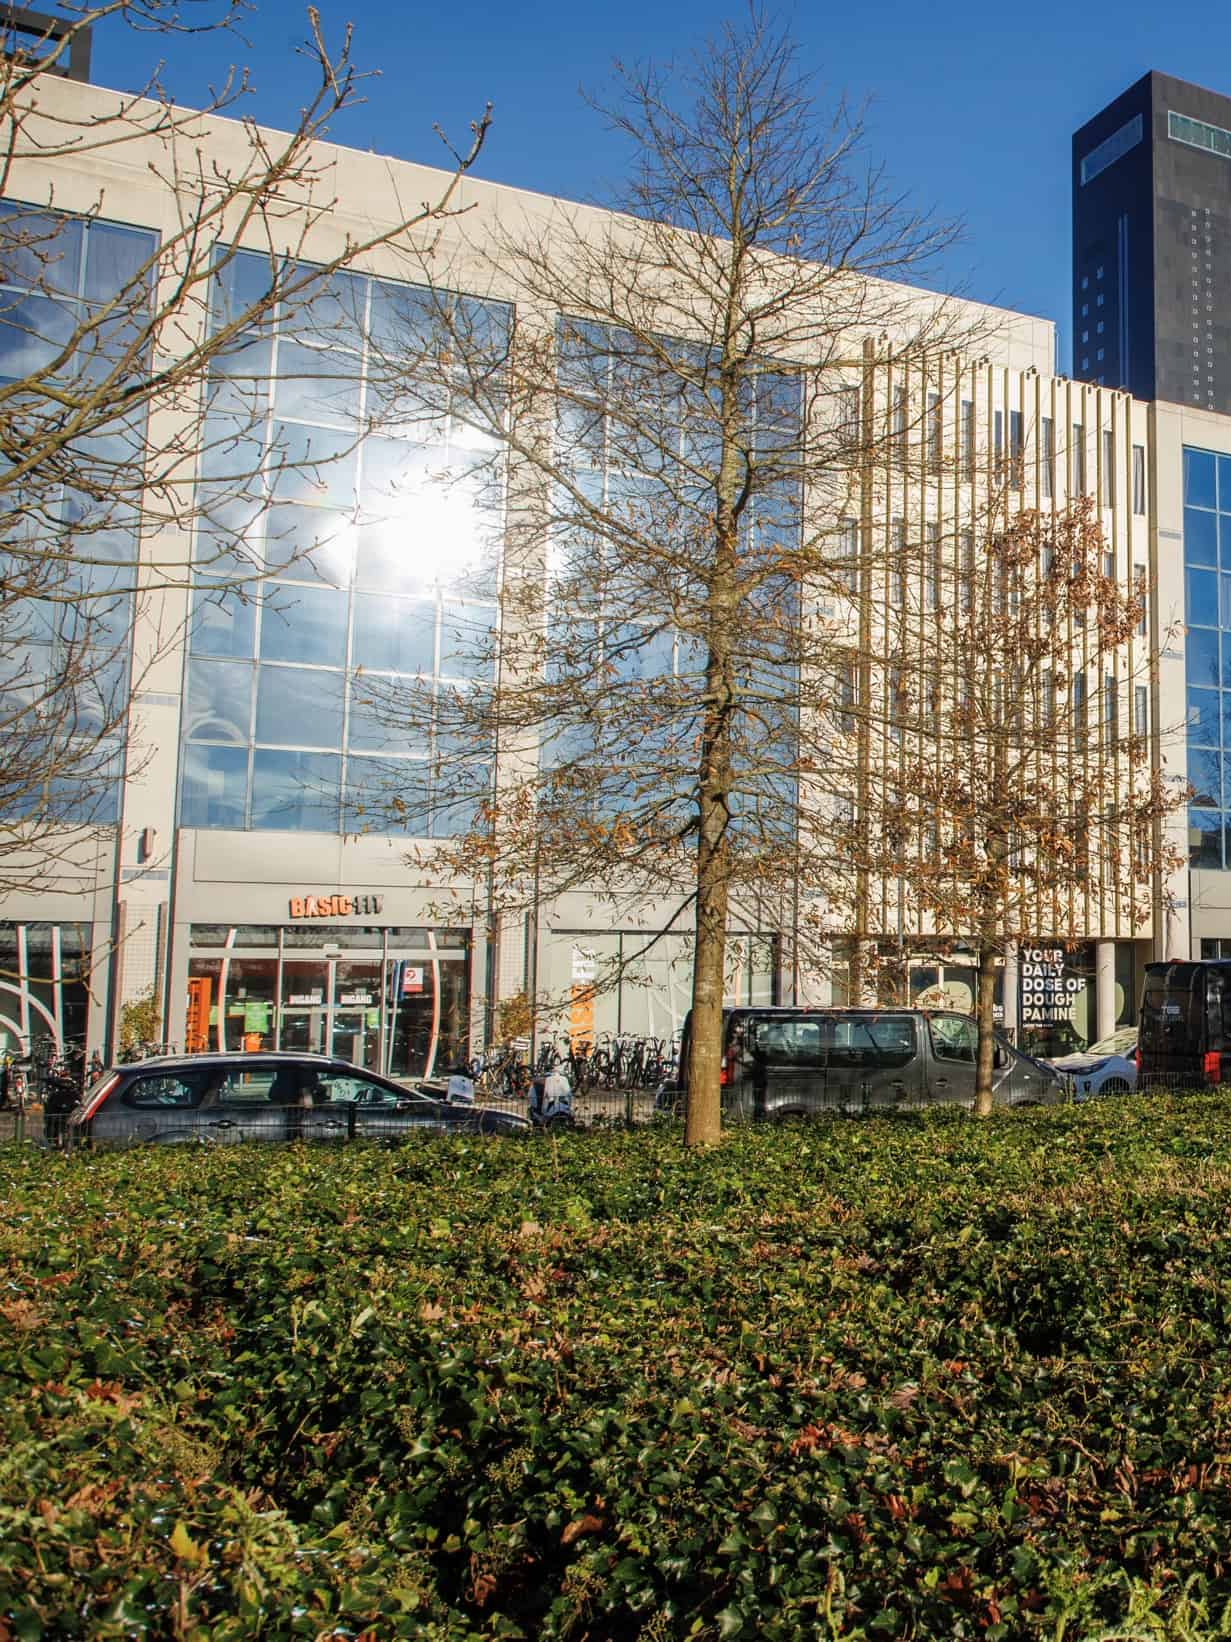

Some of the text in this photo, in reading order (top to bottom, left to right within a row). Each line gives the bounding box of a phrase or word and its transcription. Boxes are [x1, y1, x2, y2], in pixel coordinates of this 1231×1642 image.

[1023, 949, 1063, 962] YOUR
[1023, 964, 1065, 976] DAILY
[1023, 979, 1086, 991] DOSE OF
[1023, 993, 1075, 1006] DOUGH
[1023, 1007, 1077, 1020] PAMINE
